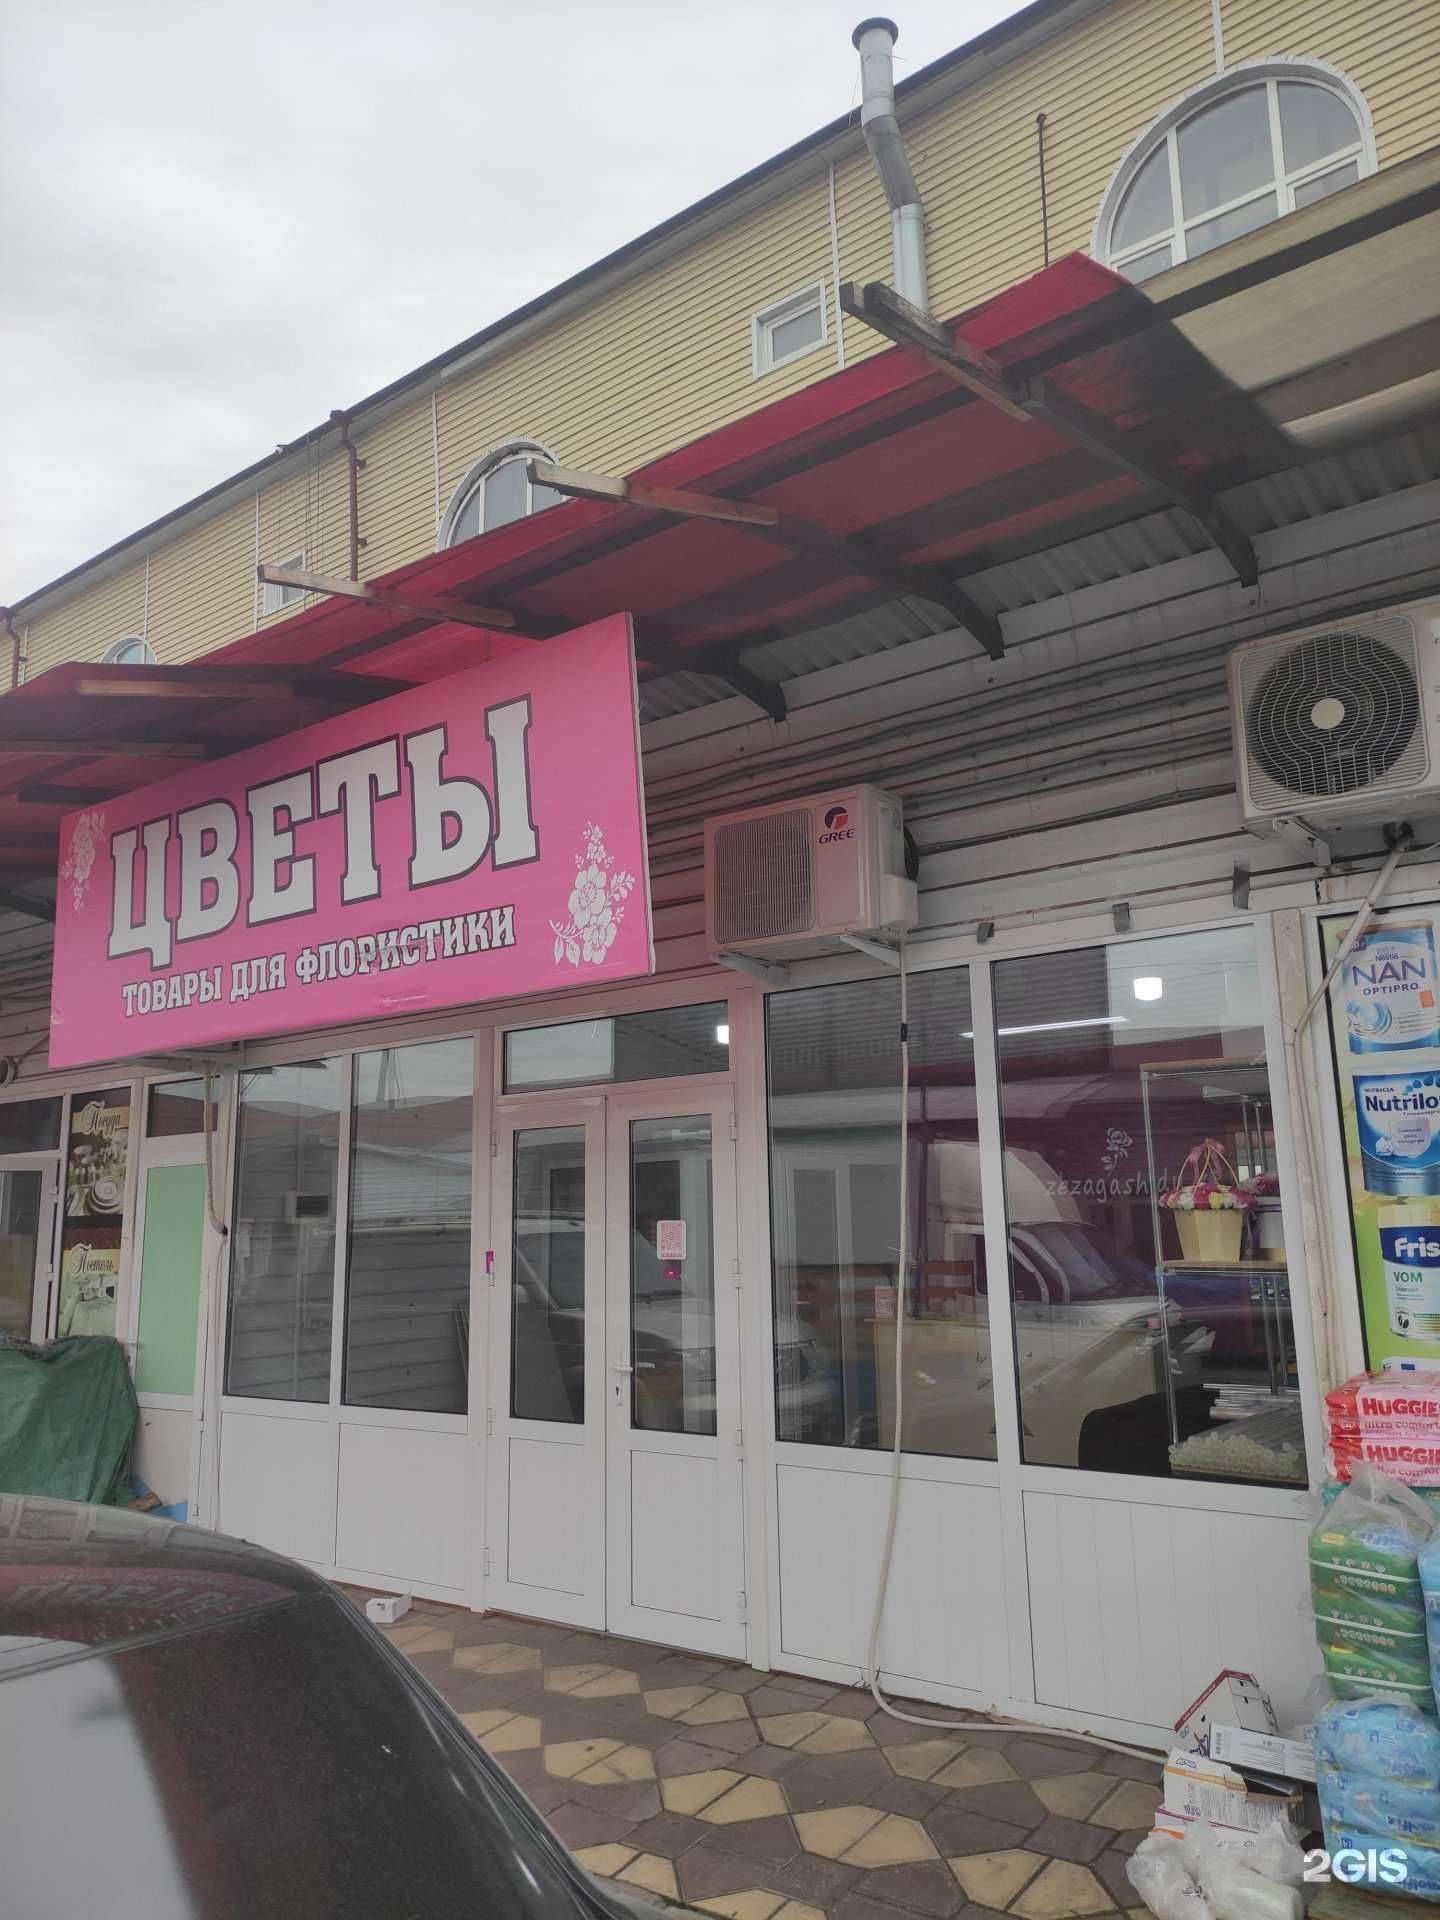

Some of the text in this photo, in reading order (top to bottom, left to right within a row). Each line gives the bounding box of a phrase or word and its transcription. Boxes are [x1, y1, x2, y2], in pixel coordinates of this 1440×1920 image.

[106, 693, 540, 971] ЦВЕТЫ
[818, 828, 857, 844] GREE
[122, 904, 517, 1018] ТОВАРЫ ДЛЯ ФЛОРИСТИКИ
[1352, 957, 1426, 986] NAN
[1363, 982, 1419, 995] OPTIPRO
[1365, 1092, 1440, 1112] Nutrilo
[1045, 1167, 1179, 1203] zezagashd
[1393, 1271, 1423, 1282] VOM
[1361, 1397, 1440, 1417] HUGGIE
